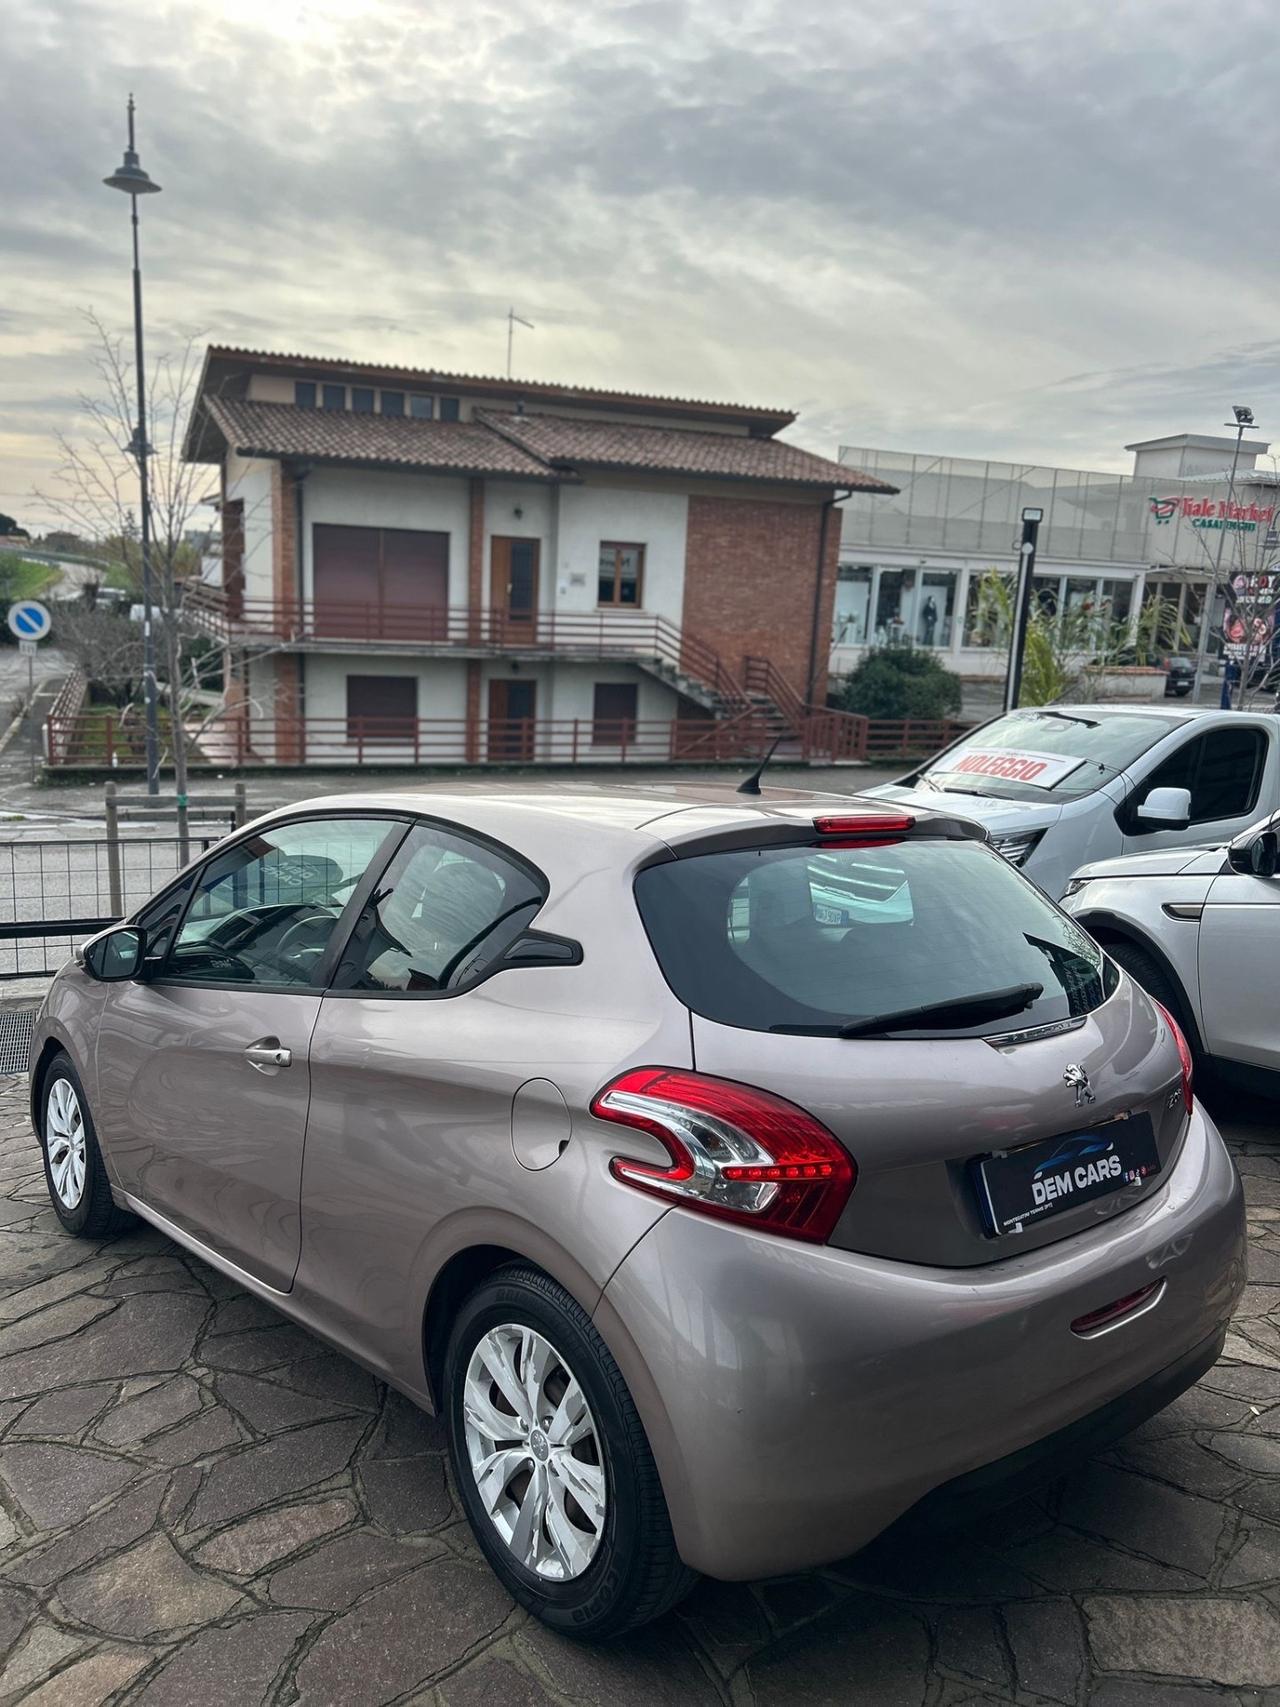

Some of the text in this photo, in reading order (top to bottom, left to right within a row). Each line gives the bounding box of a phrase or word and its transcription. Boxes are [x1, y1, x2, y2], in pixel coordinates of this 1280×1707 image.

[1218, 500, 1275, 525] Market
[951, 755, 1048, 781] NOLEGGIO
[1032, 1155, 1121, 1206] DEM CARS
